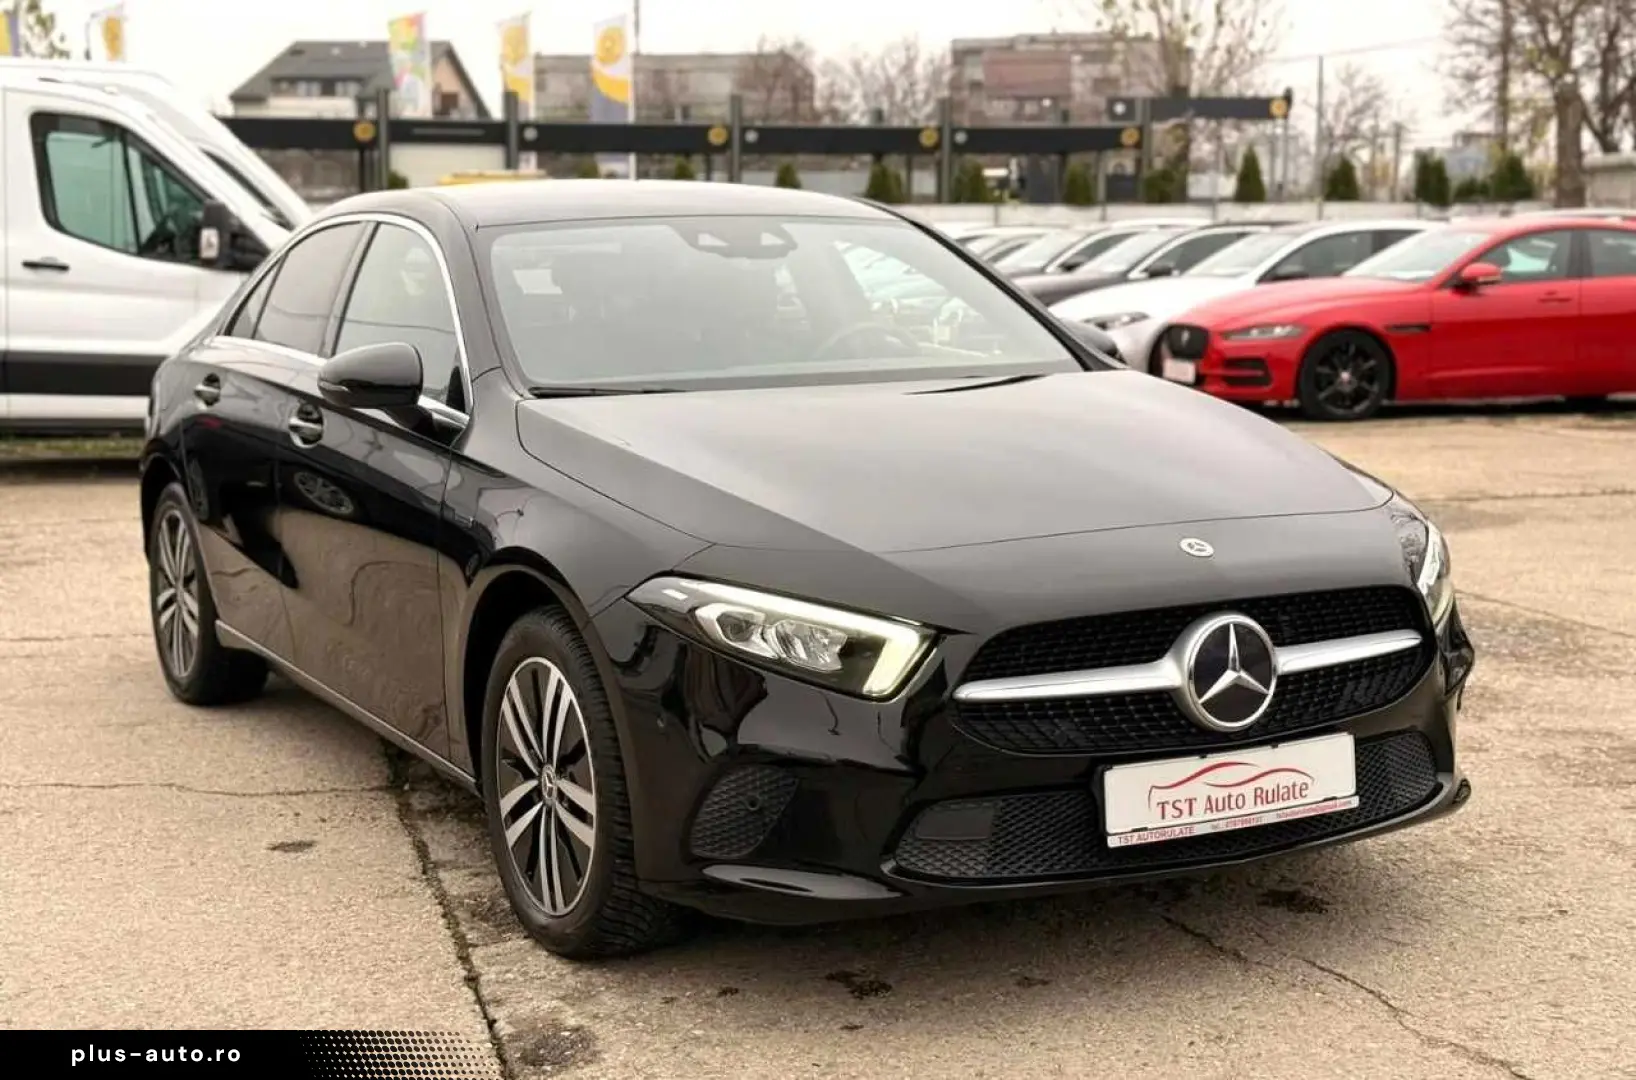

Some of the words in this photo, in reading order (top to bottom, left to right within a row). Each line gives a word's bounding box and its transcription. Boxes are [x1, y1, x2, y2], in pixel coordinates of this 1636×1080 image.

[1157, 798, 1197, 820] TST
[1204, 792, 1246, 814] Auto
[1254, 782, 1309, 806] Rulate
[1118, 835, 1135, 845] TST
[1136, 827, 1195, 842] AUTORULATE
